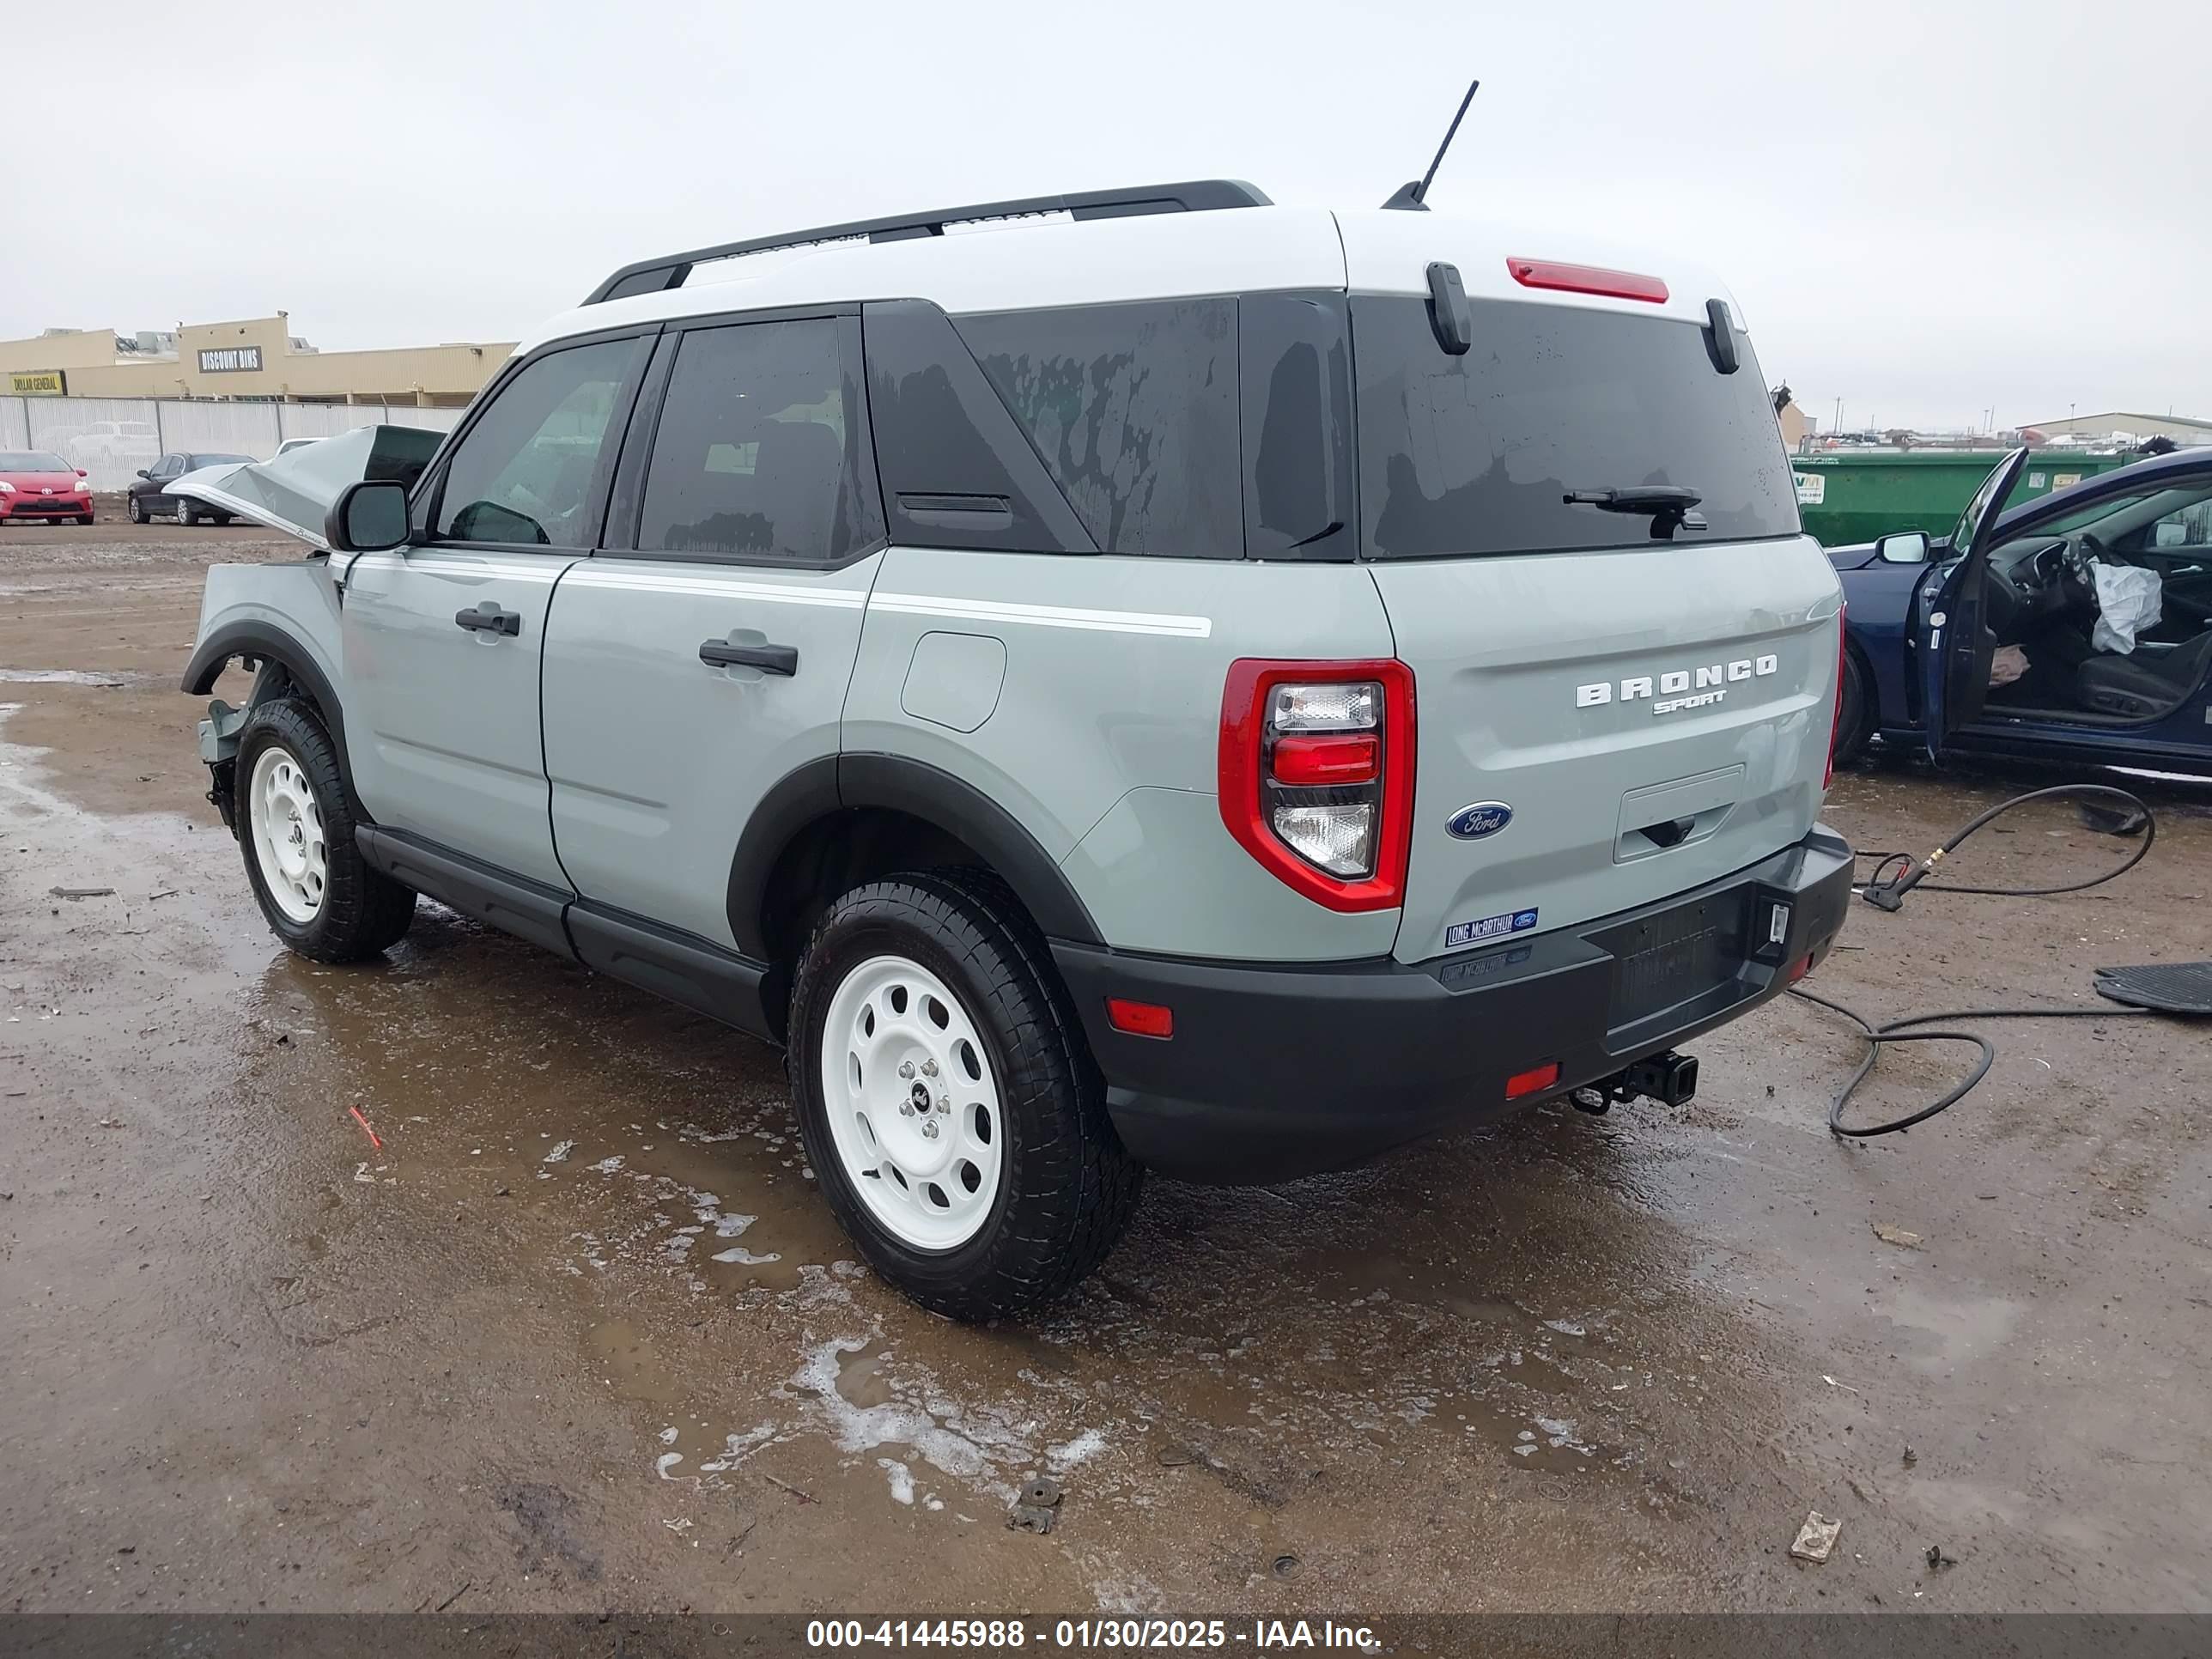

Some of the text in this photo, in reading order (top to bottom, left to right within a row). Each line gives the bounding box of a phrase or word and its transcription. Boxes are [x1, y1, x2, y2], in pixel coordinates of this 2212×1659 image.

[201, 349, 258, 371] DISCOUNT BINS
[14, 376, 58, 392] DOLLAR GENERAL
[1577, 654, 1778, 708] BRONCO
[1652, 690, 1727, 714] SPORT
[1464, 810, 1502, 833] Ford
[1448, 924, 1469, 946] LONG
[1471, 915, 1514, 938] McARTHUR
[981, 1089, 1023, 1273] CONTINEN
